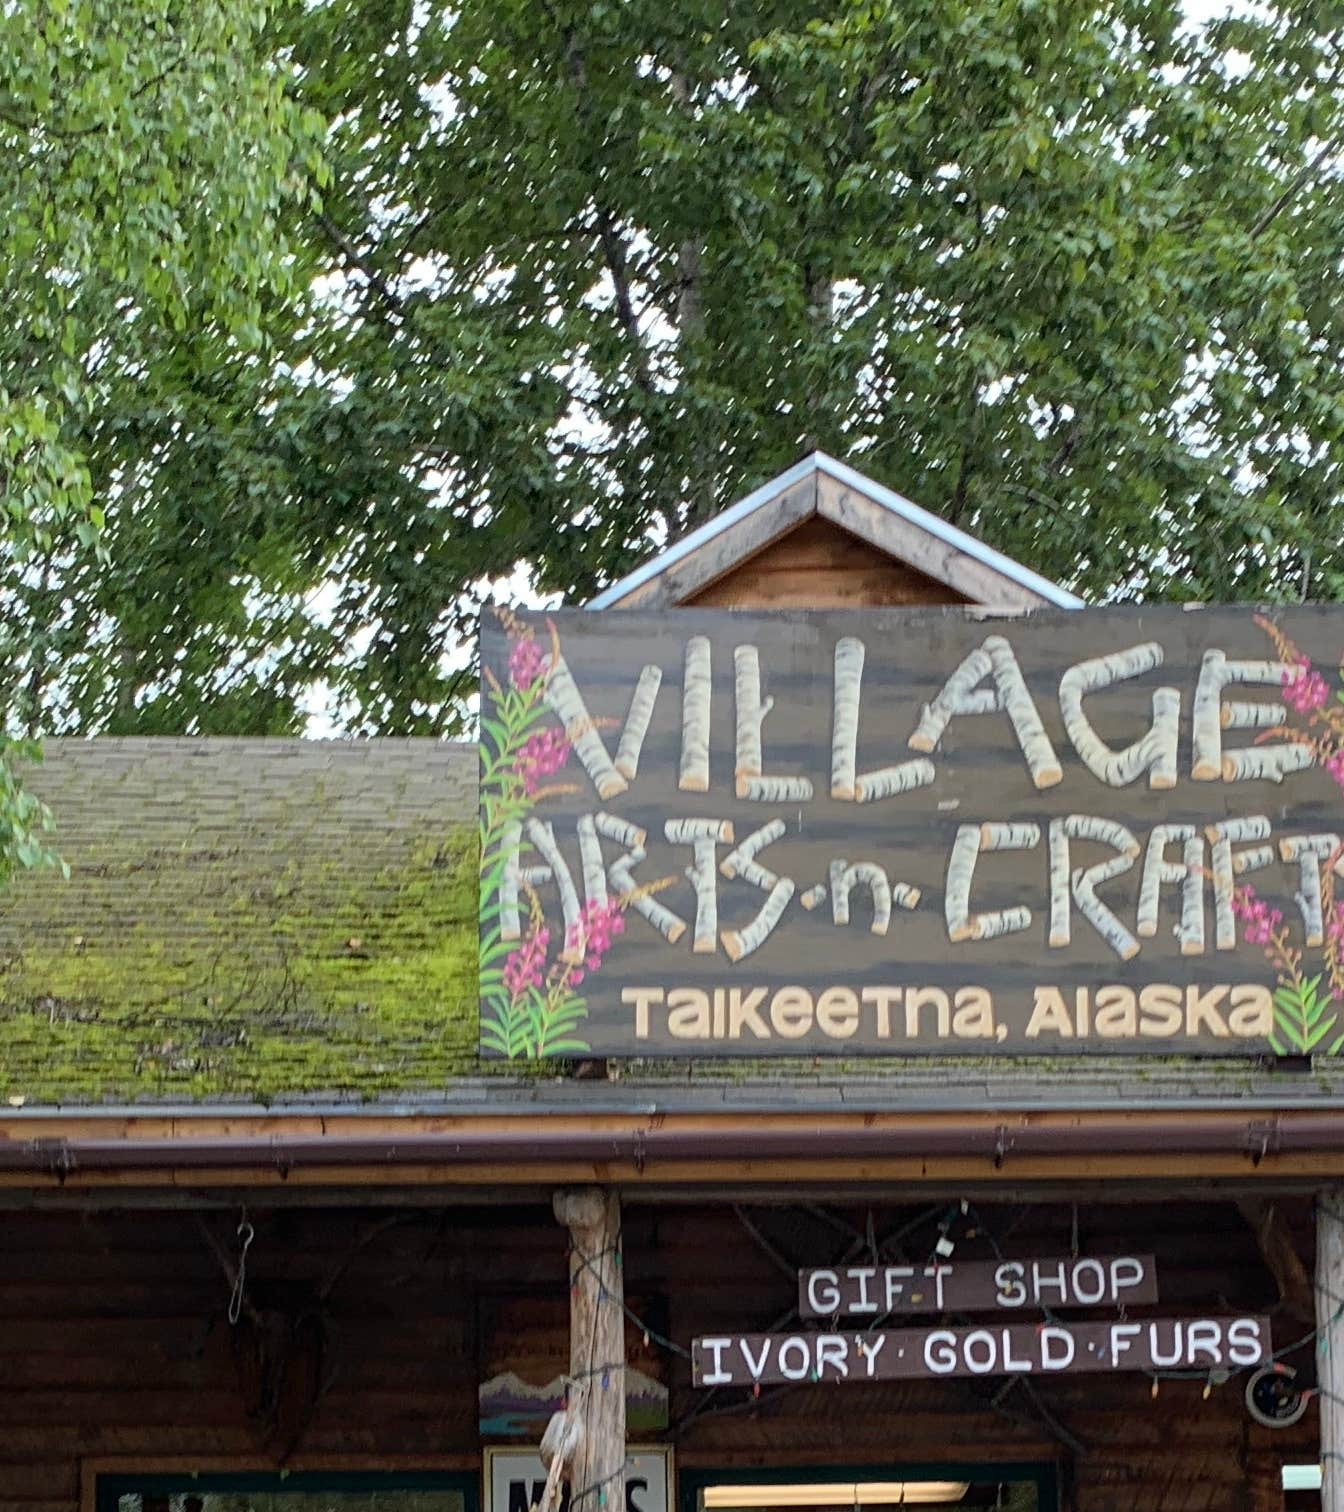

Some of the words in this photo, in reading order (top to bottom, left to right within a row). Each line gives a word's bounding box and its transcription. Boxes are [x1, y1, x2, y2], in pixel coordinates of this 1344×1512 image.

[545, 633, 1315, 800] VILLAGE
[500, 812, 794, 964] ARTS
[807, 1265, 953, 1315] GIFT
[994, 1257, 1144, 1308] SHOP
[701, 1333, 886, 1385] IVORY
[924, 1327, 1075, 1374] GOLD
[1110, 1318, 1262, 1368] FURS
